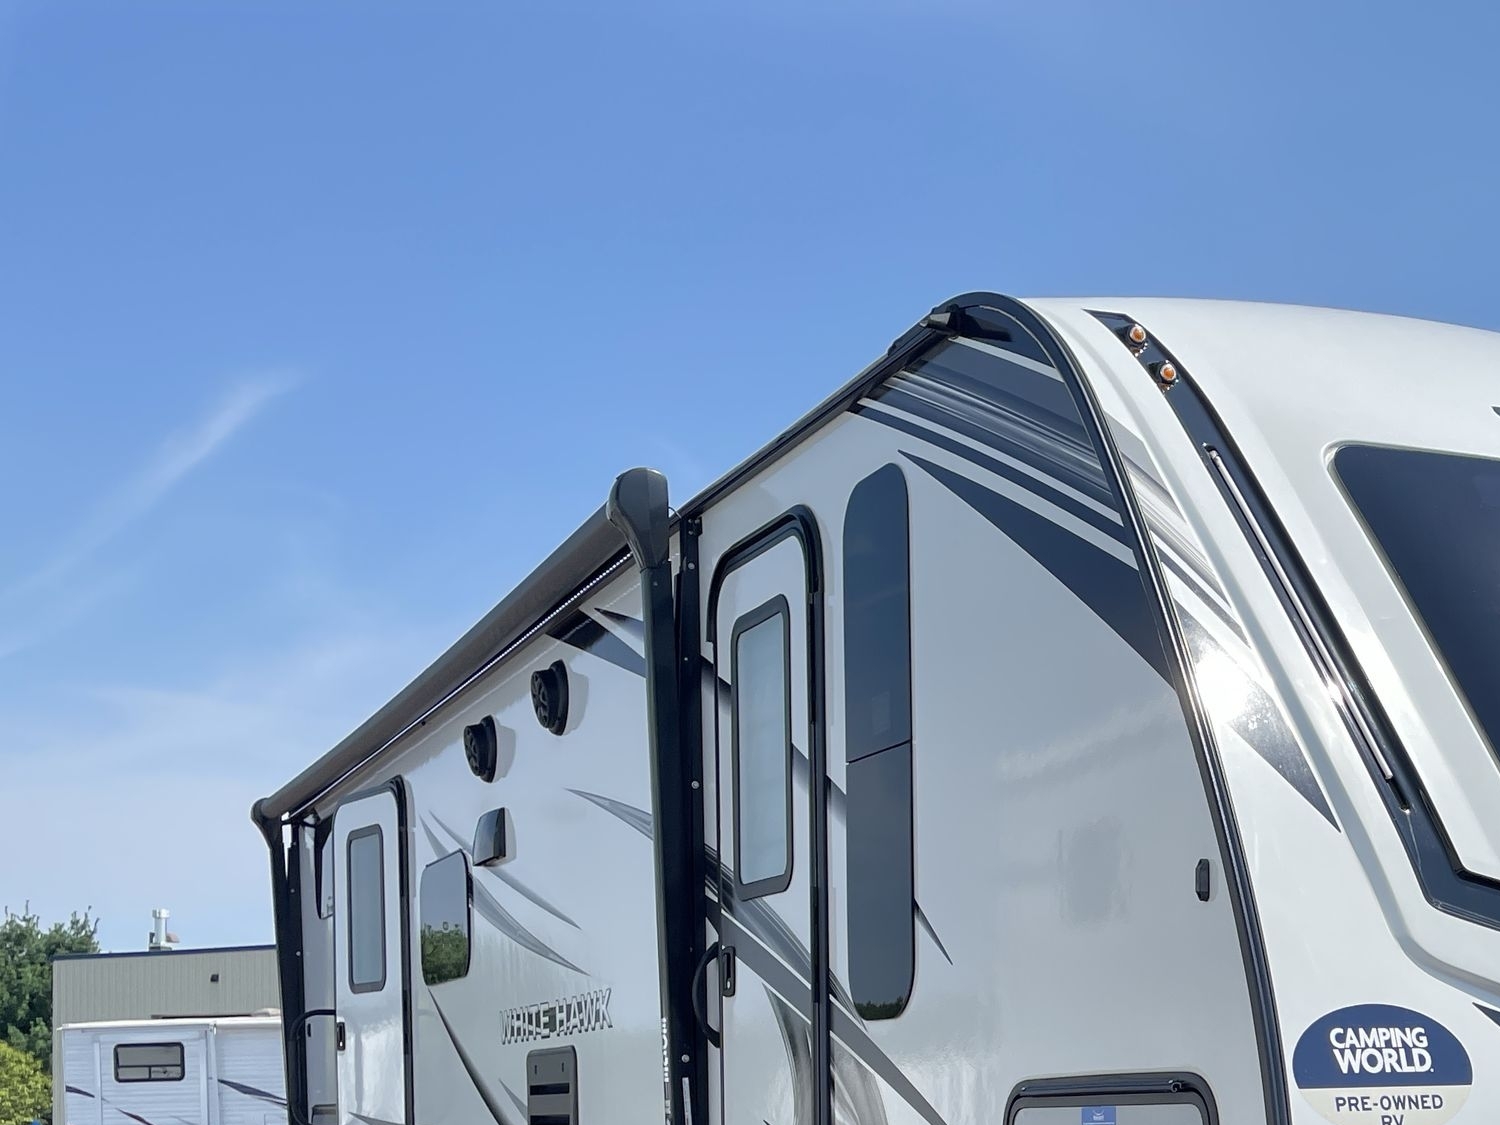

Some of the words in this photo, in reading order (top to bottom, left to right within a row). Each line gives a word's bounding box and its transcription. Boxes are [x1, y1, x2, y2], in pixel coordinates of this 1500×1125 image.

[499, 1002, 550, 1045] WHITE
[555, 988, 613, 1037] HAWK
[1329, 1027, 1428, 1049] CAMPING
[1335, 1094, 1443, 1112] PRE-OWNED
